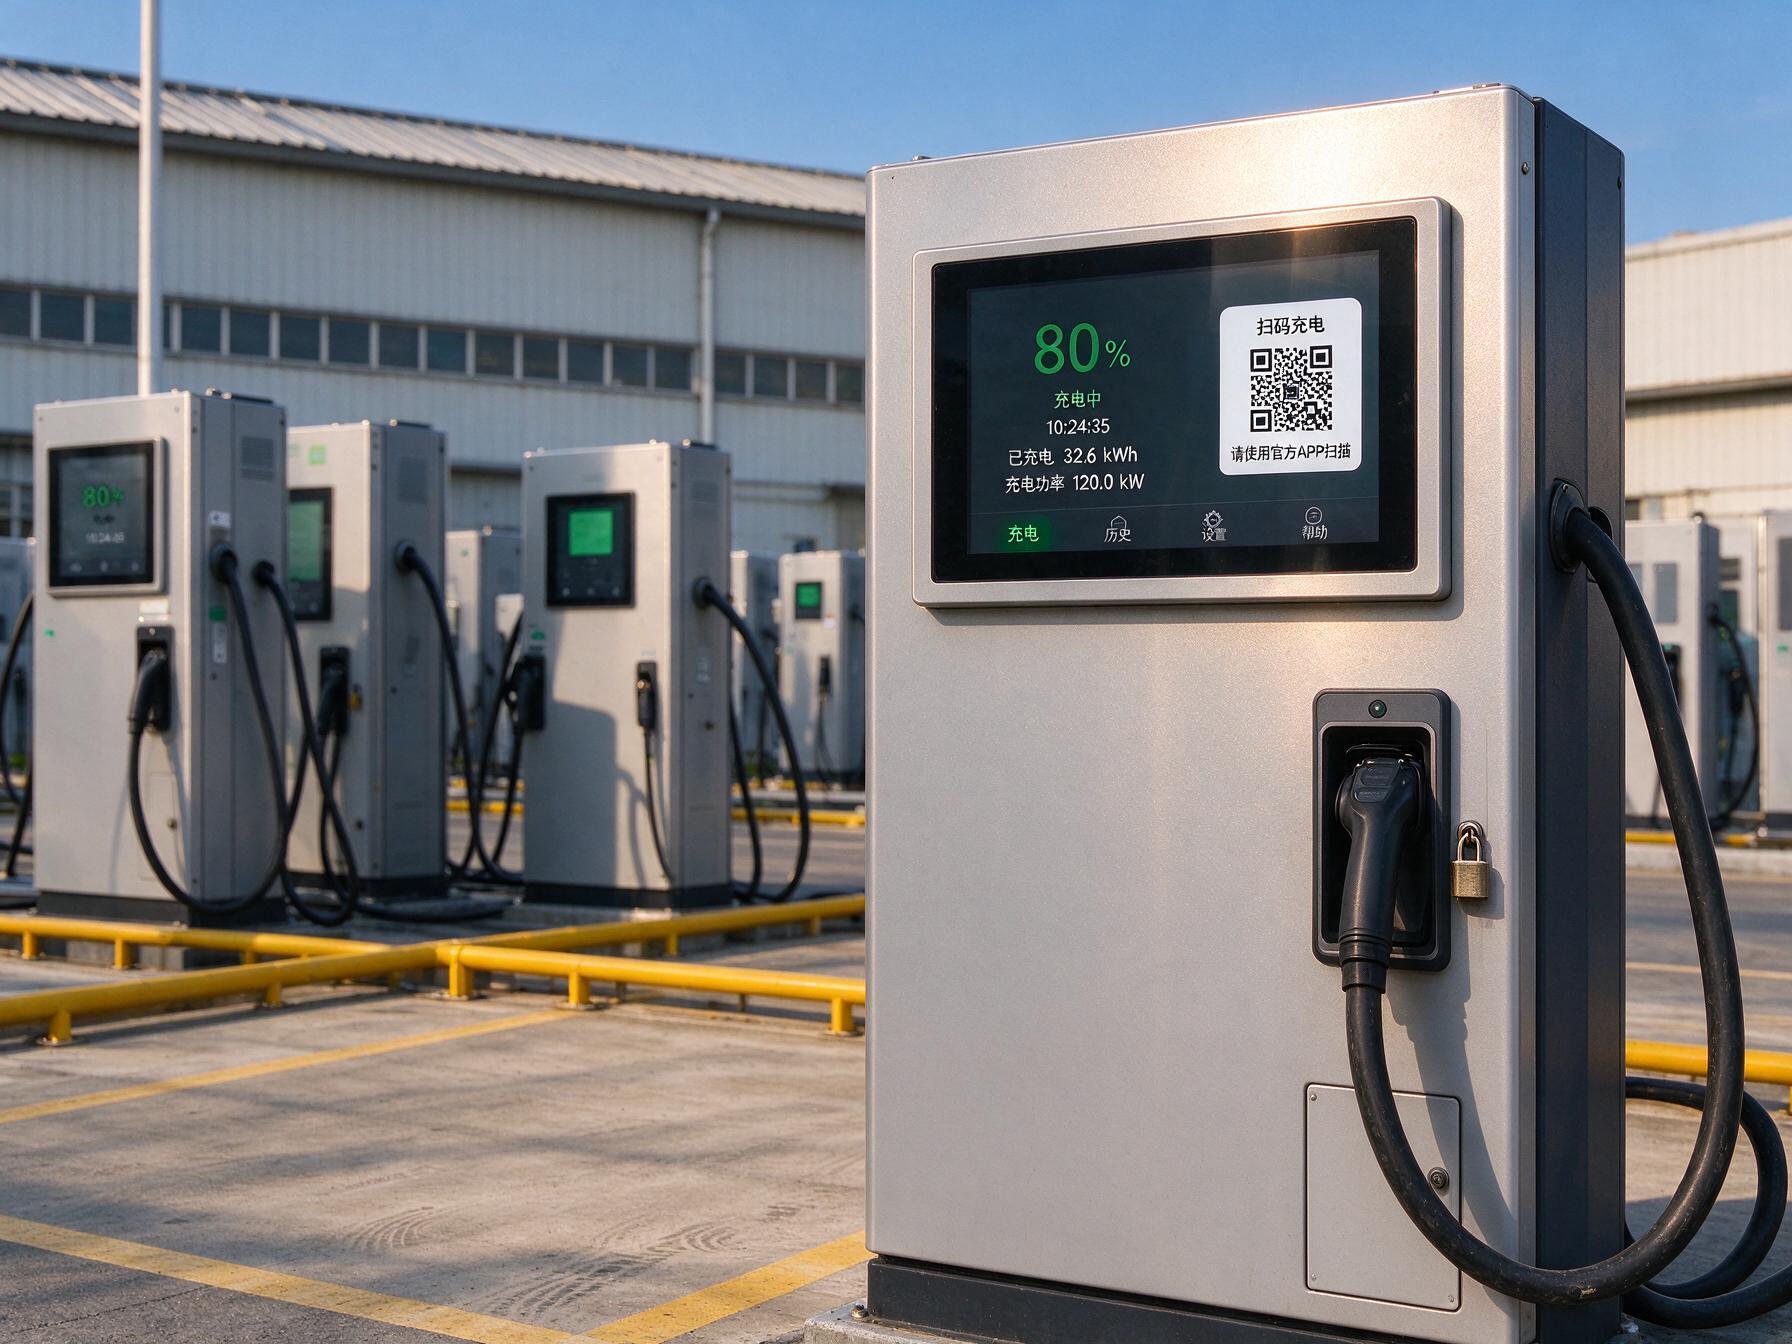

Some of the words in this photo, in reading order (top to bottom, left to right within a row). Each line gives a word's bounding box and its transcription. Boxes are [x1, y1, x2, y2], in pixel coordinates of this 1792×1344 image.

[1256, 314, 1325, 336] 扫码充电
[1035, 323, 1131, 374] 80%
[1054, 389, 1101, 409] 充电中
[1046, 418, 1110, 435] 10:24:35
[1008, 448, 1055, 467] 已充电
[1063, 447, 1097, 464] 32.6
[1103, 445, 1138, 463] kWh
[1231, 442, 1351, 463] 请使用官方APP扫描
[1005, 473, 1065, 494] 充电功率
[1072, 473, 1114, 491] 120.0
[1119, 473, 1145, 490] kW
[1007, 524, 1040, 543] 充电
[1104, 527, 1132, 543] 历史
[1302, 525, 1328, 540] 帮助
